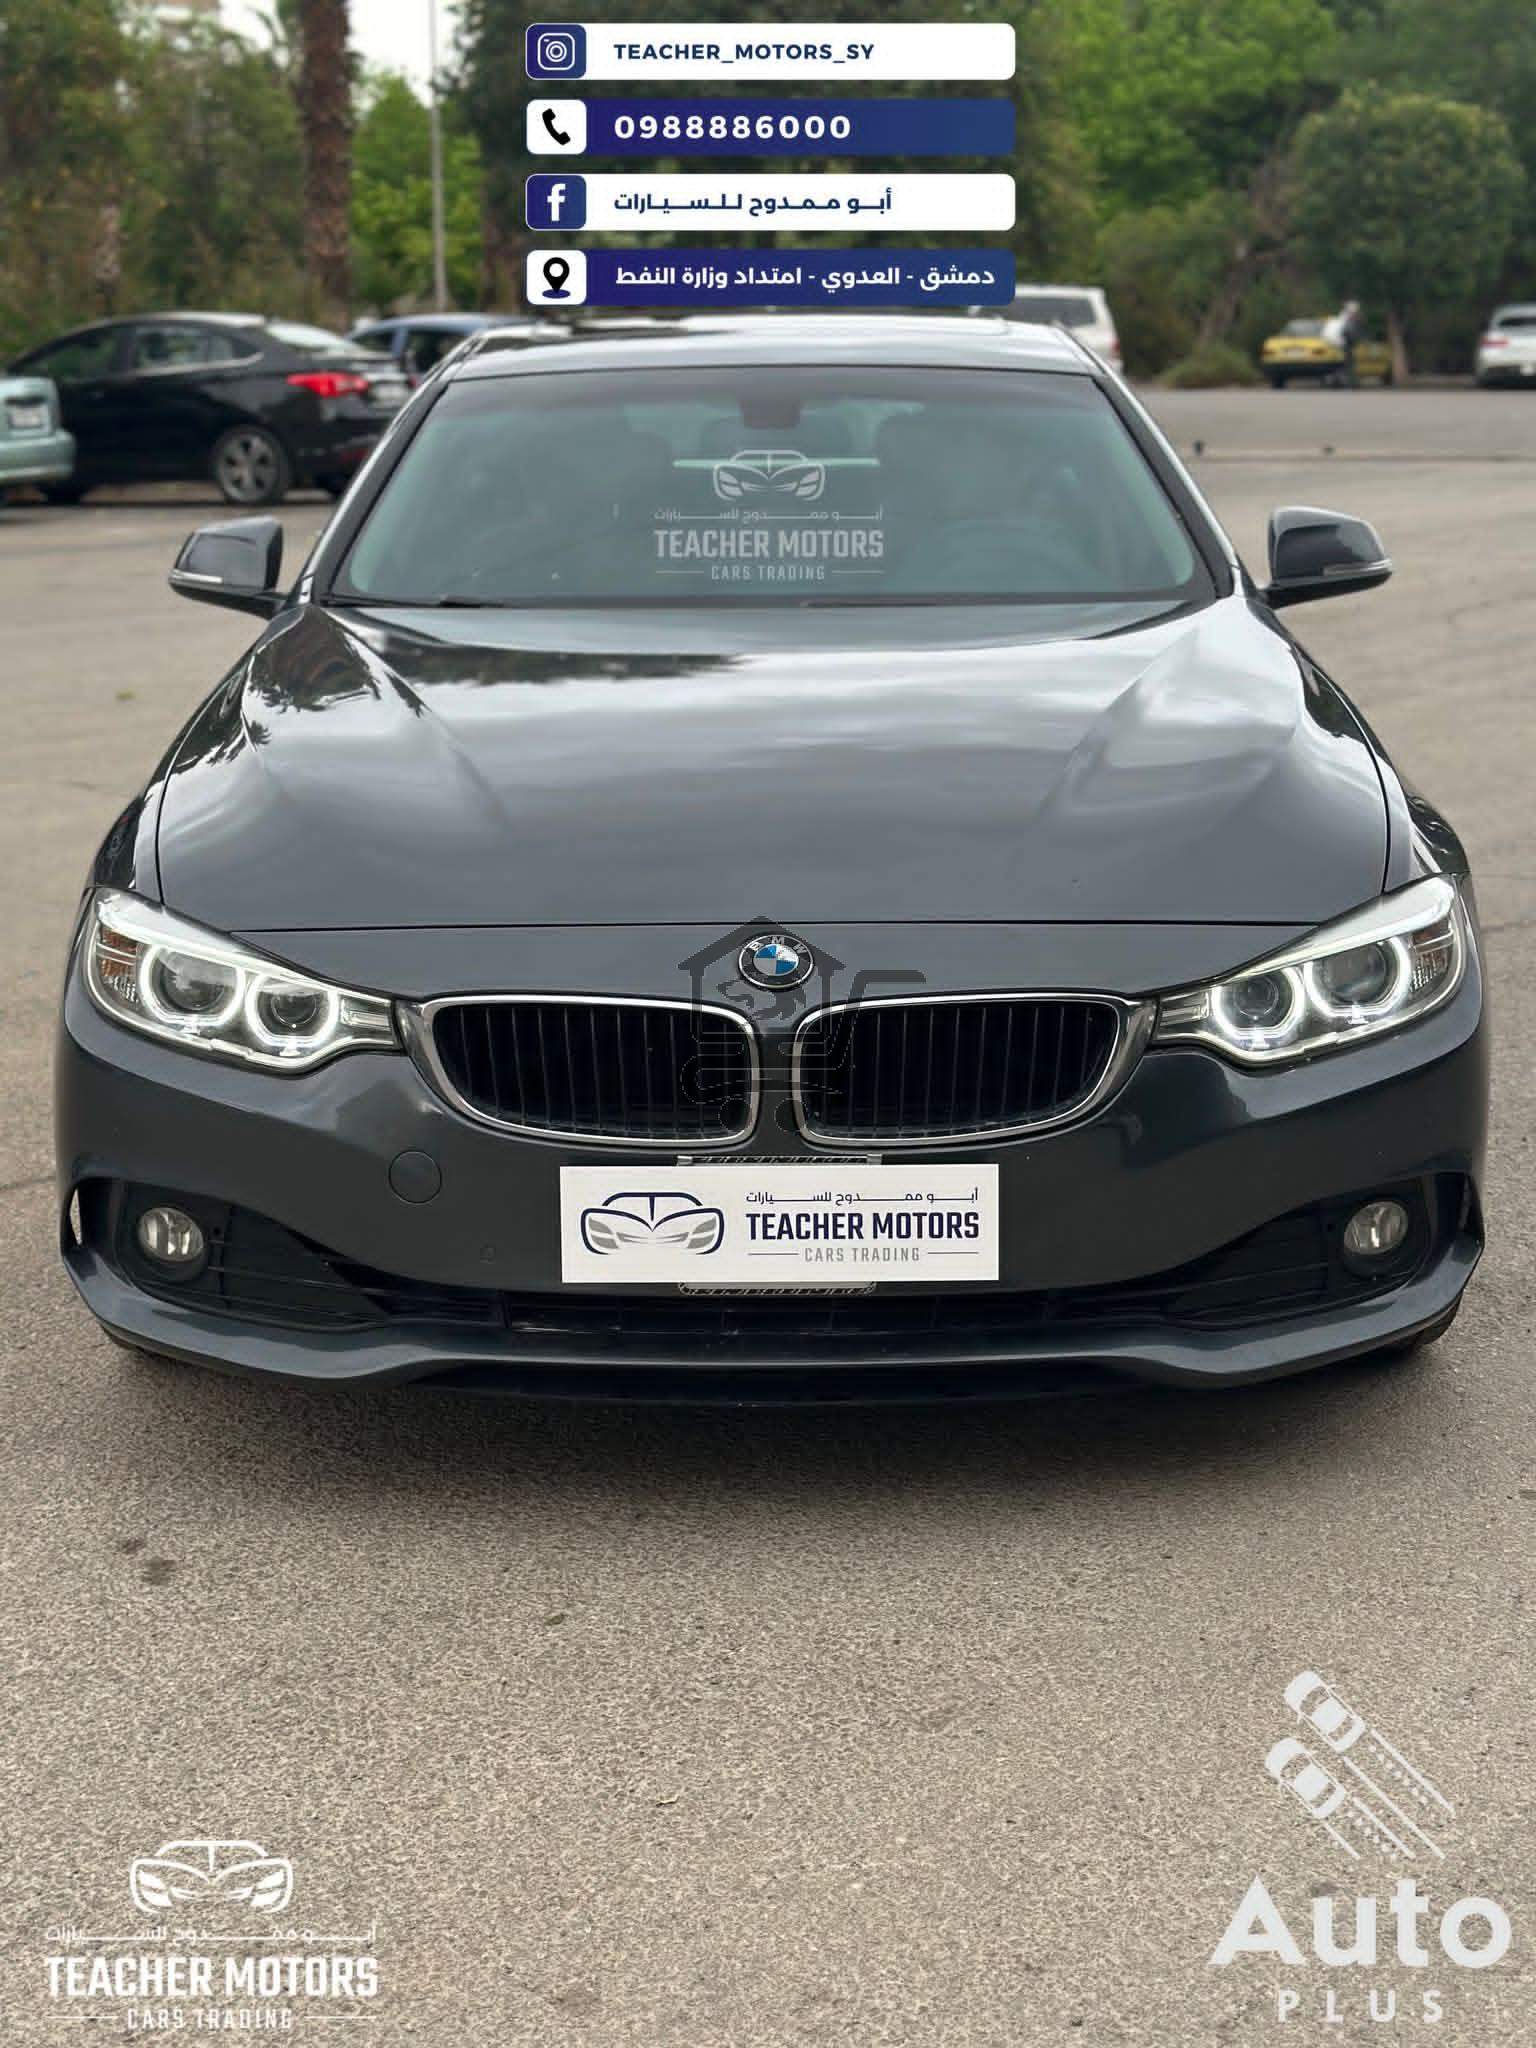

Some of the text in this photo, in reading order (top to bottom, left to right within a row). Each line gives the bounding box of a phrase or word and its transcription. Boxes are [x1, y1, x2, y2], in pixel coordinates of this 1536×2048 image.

[749, 936, 807, 954] BMW
[746, 1212, 980, 1240] TEACHER MOTORS
[804, 1247, 920, 1262] CARS TRADING
